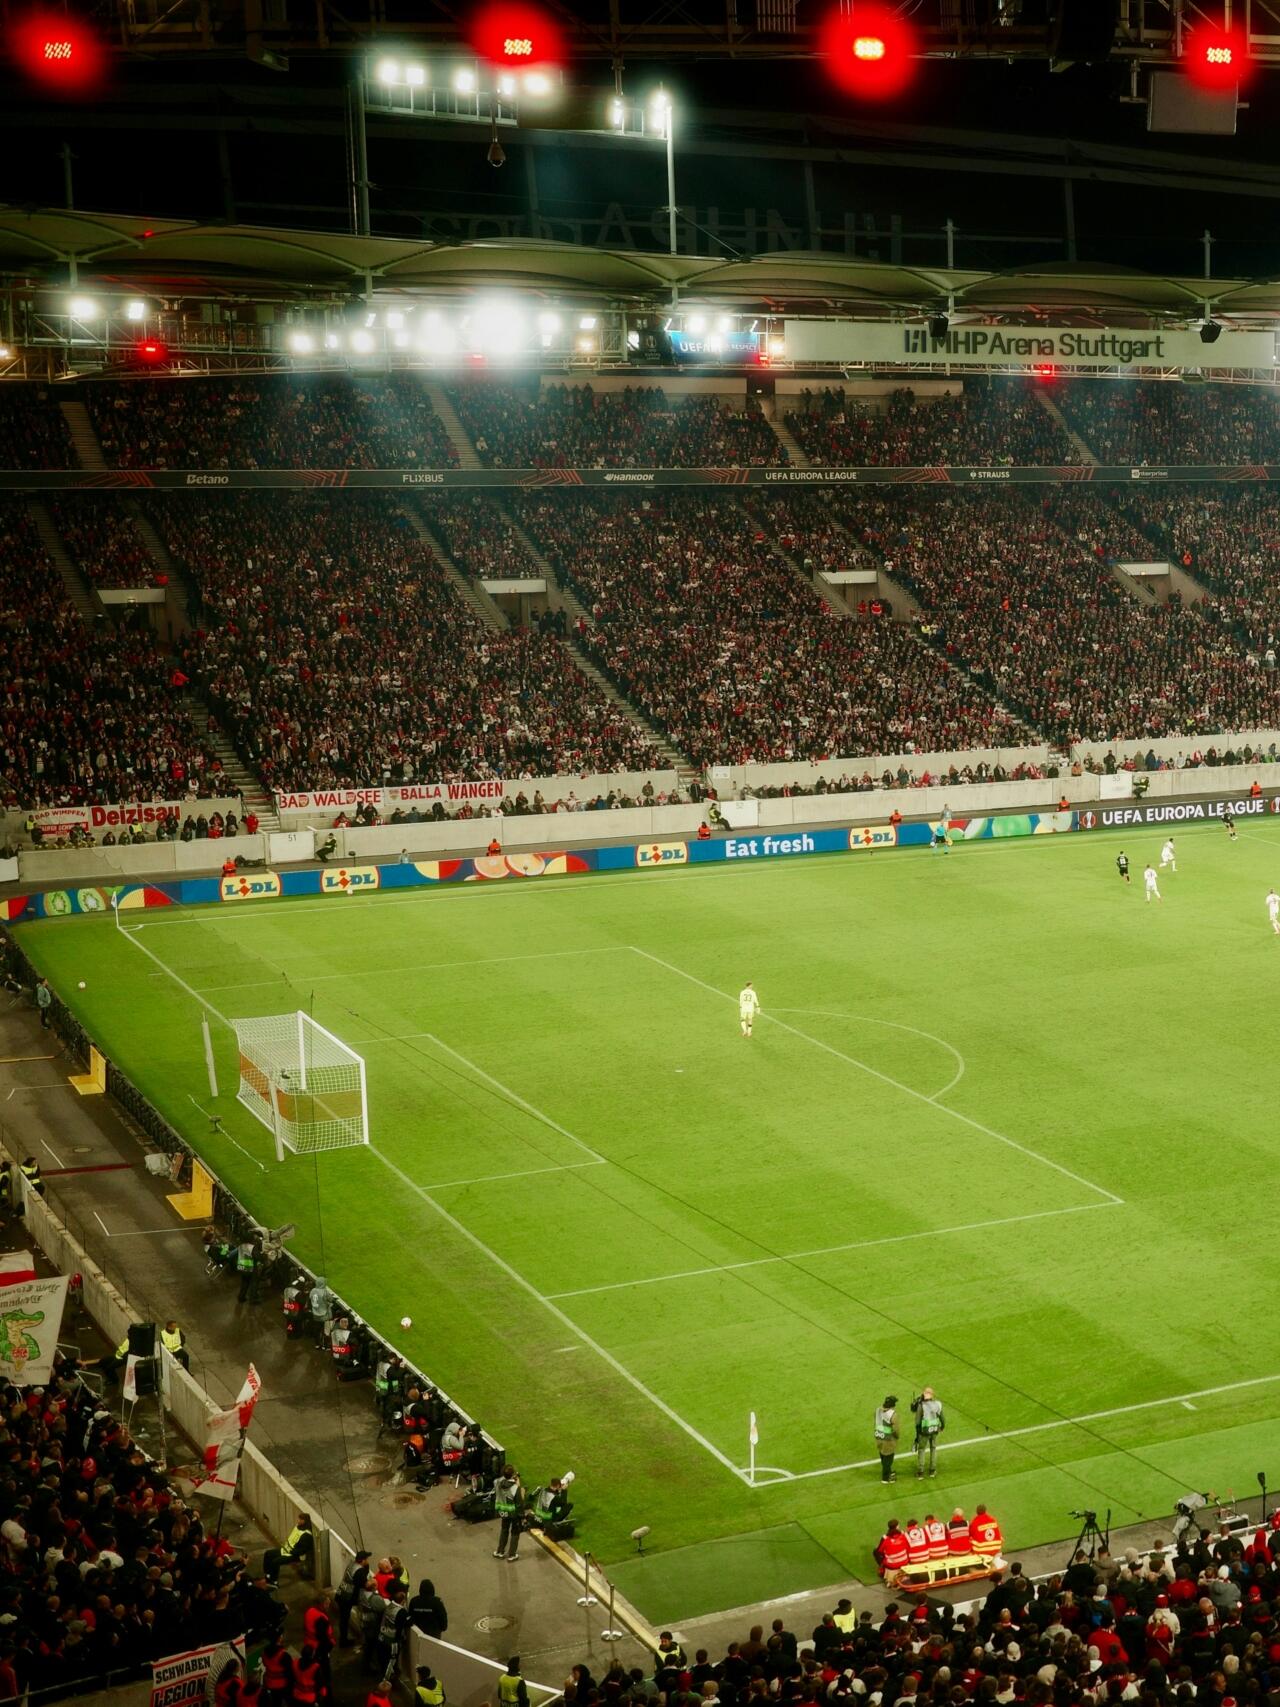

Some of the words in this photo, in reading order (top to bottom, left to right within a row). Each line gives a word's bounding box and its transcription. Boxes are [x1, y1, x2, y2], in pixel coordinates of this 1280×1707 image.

[1059, 333, 1164, 363] Stuttgart
[186, 474, 229, 484] Betano
[765, 471, 788, 480] UEFA
[789, 471, 823, 480] EUROPA
[824, 471, 857, 480] LEAGUE
[977, 471, 1010, 479] STRAUSS
[279, 794, 310, 809] BAD
[313, 789, 382, 807] WALDSEE
[400, 785, 442, 800] BALLA
[447, 782, 504, 800] WANGEN
[35, 811, 50, 820] BAD
[51, 809, 86, 817] WIMPFEN
[90, 802, 181, 828] Deizisau
[1102, 809, 1143, 826] UEFA
[1146, 804, 1205, 822] EUROPA
[1208, 799, 1265, 818] LEAGUE
[725, 839, 758, 858] Eat
[762, 833, 815, 854] fresh
[852, 828, 894, 846] LIDL
[639, 845, 685, 863] LIDL
[224, 877, 277, 897] LIDL
[325, 870, 376, 889] LIDL
[154, 1655, 211, 1684] SCHWABEN
[153, 1676, 209, 1707] LEGION
